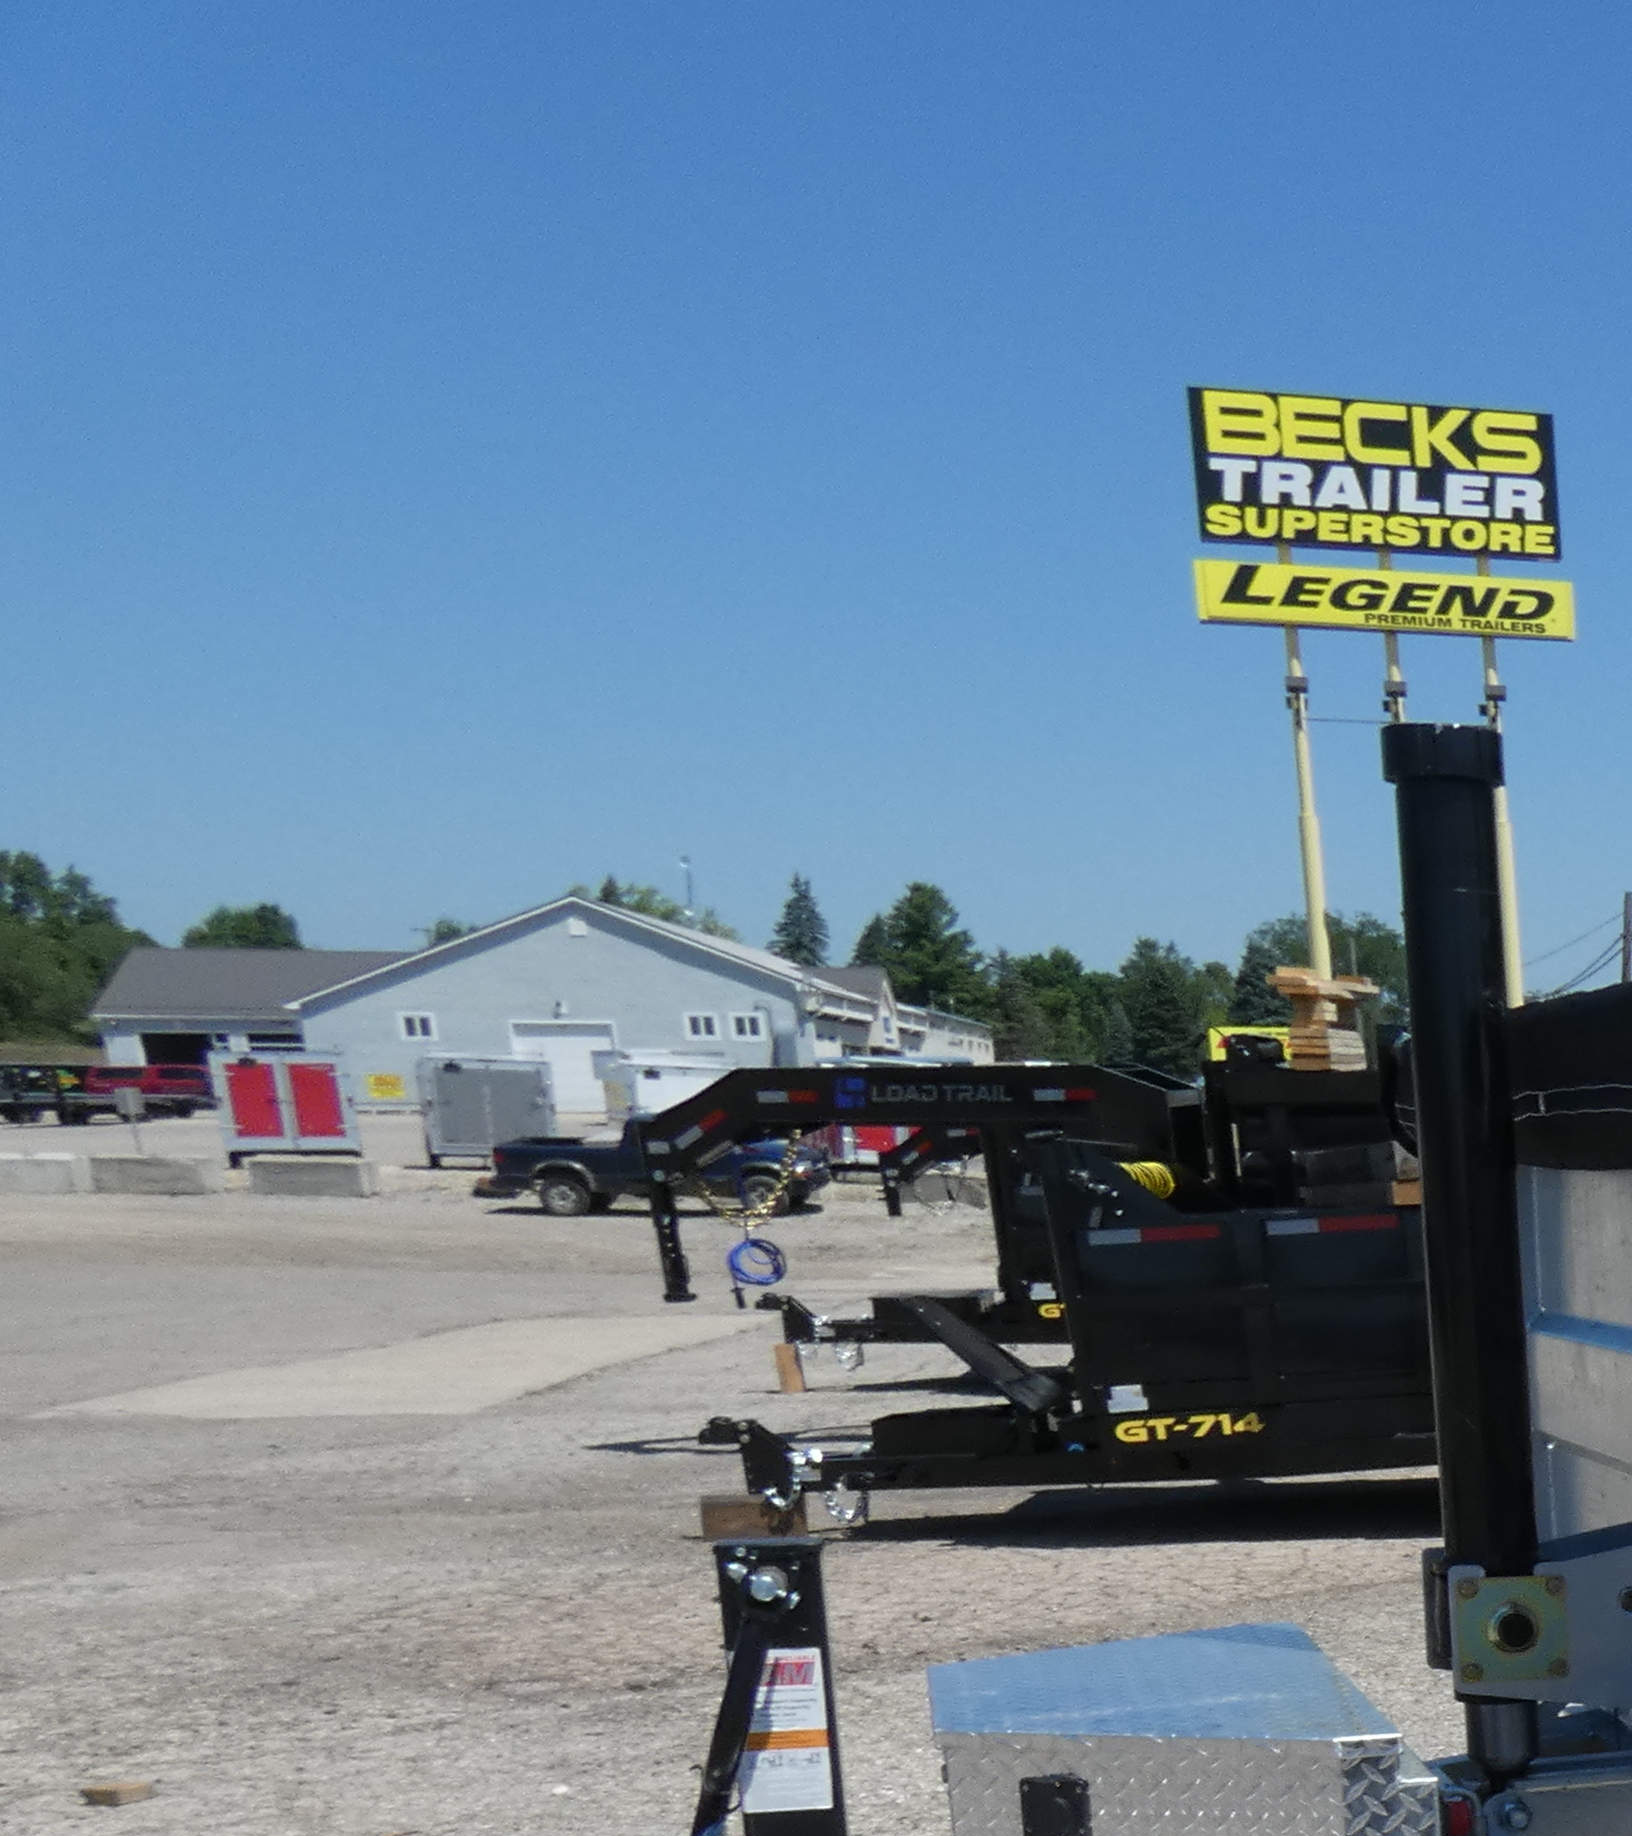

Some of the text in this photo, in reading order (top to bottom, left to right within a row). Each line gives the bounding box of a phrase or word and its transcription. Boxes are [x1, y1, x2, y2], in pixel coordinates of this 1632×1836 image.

[1202, 389, 1544, 475] BECKS
[1207, 457, 1547, 521] TRAILER
[1204, 503, 1556, 555] SUPERSTORE
[1219, 564, 1556, 621] LEGEND
[1363, 612, 1547, 635] PREMIUM TRAILERS
[871, 1083, 1014, 1103] LOAD TRAIL
[1114, 1411, 1266, 1443] GT-714
